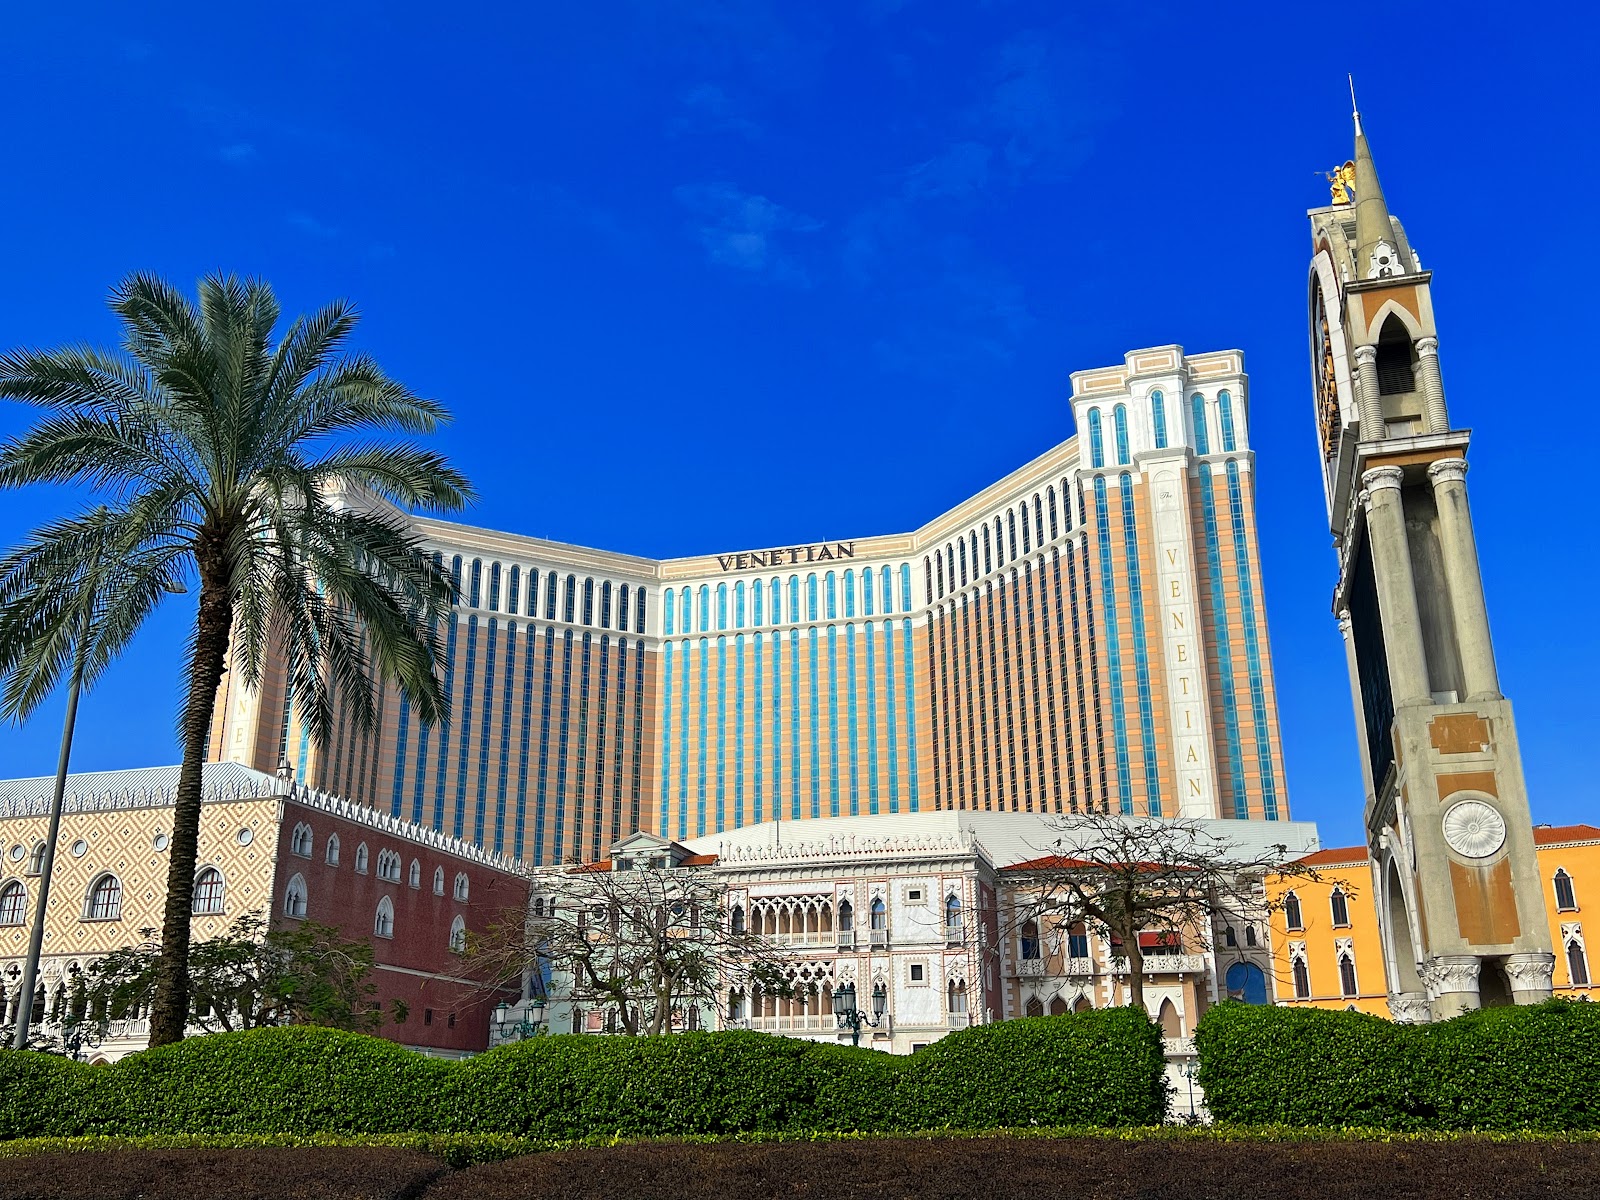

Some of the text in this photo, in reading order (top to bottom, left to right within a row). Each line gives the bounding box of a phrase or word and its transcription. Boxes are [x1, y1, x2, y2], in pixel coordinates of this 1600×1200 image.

[1160, 491, 1172, 499] The
[717, 542, 856, 572] VENETIAN
[1166, 548, 1201, 797] VENETIAN
